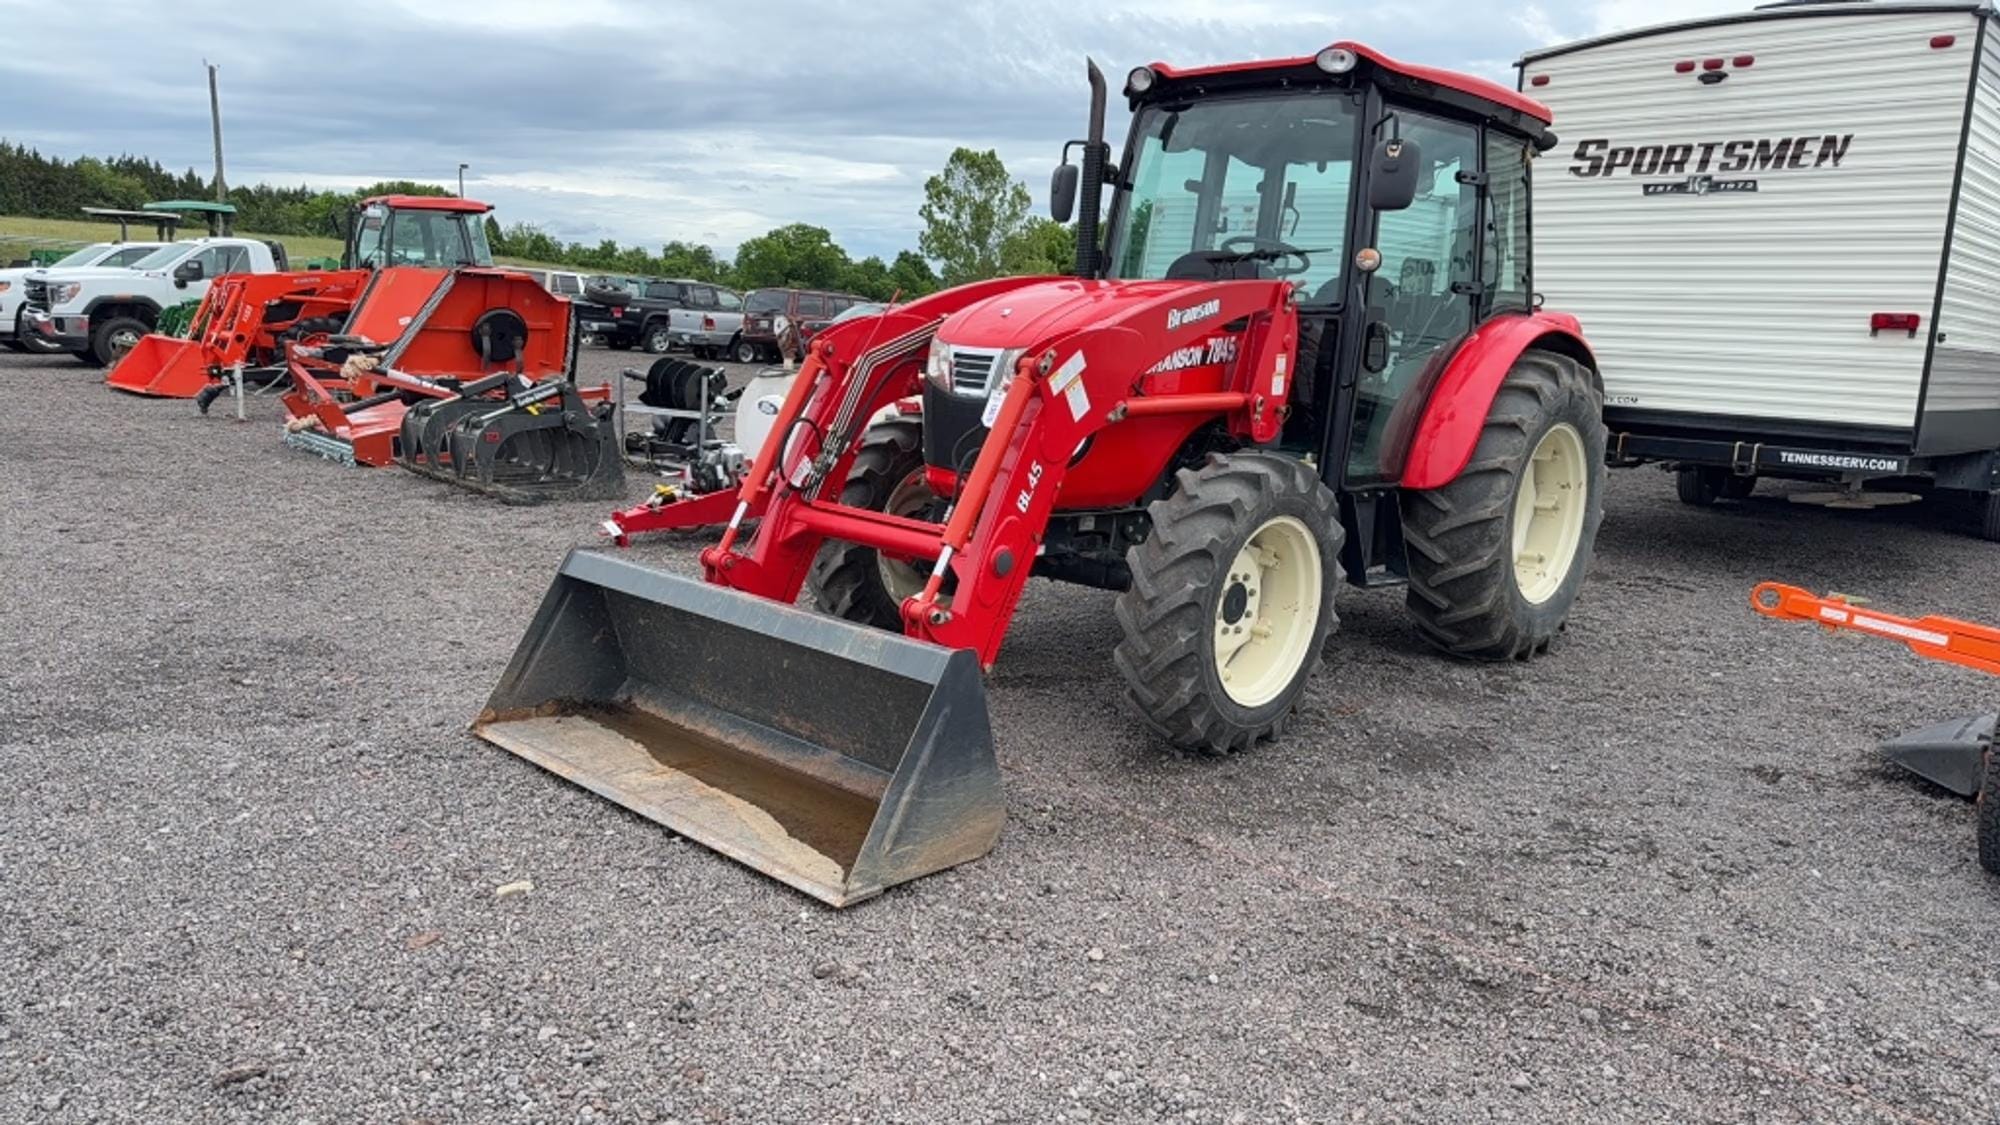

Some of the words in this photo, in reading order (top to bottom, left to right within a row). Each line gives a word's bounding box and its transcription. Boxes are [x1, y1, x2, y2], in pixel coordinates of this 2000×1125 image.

[1569, 134, 1854, 177] SPORTSMEN
[1167, 299, 1220, 330] Branson
[1146, 345, 1205, 374] RANSON
[1206, 335, 1236, 364] 7845
[1780, 451, 1898, 471] TENNESSEERV.COM
